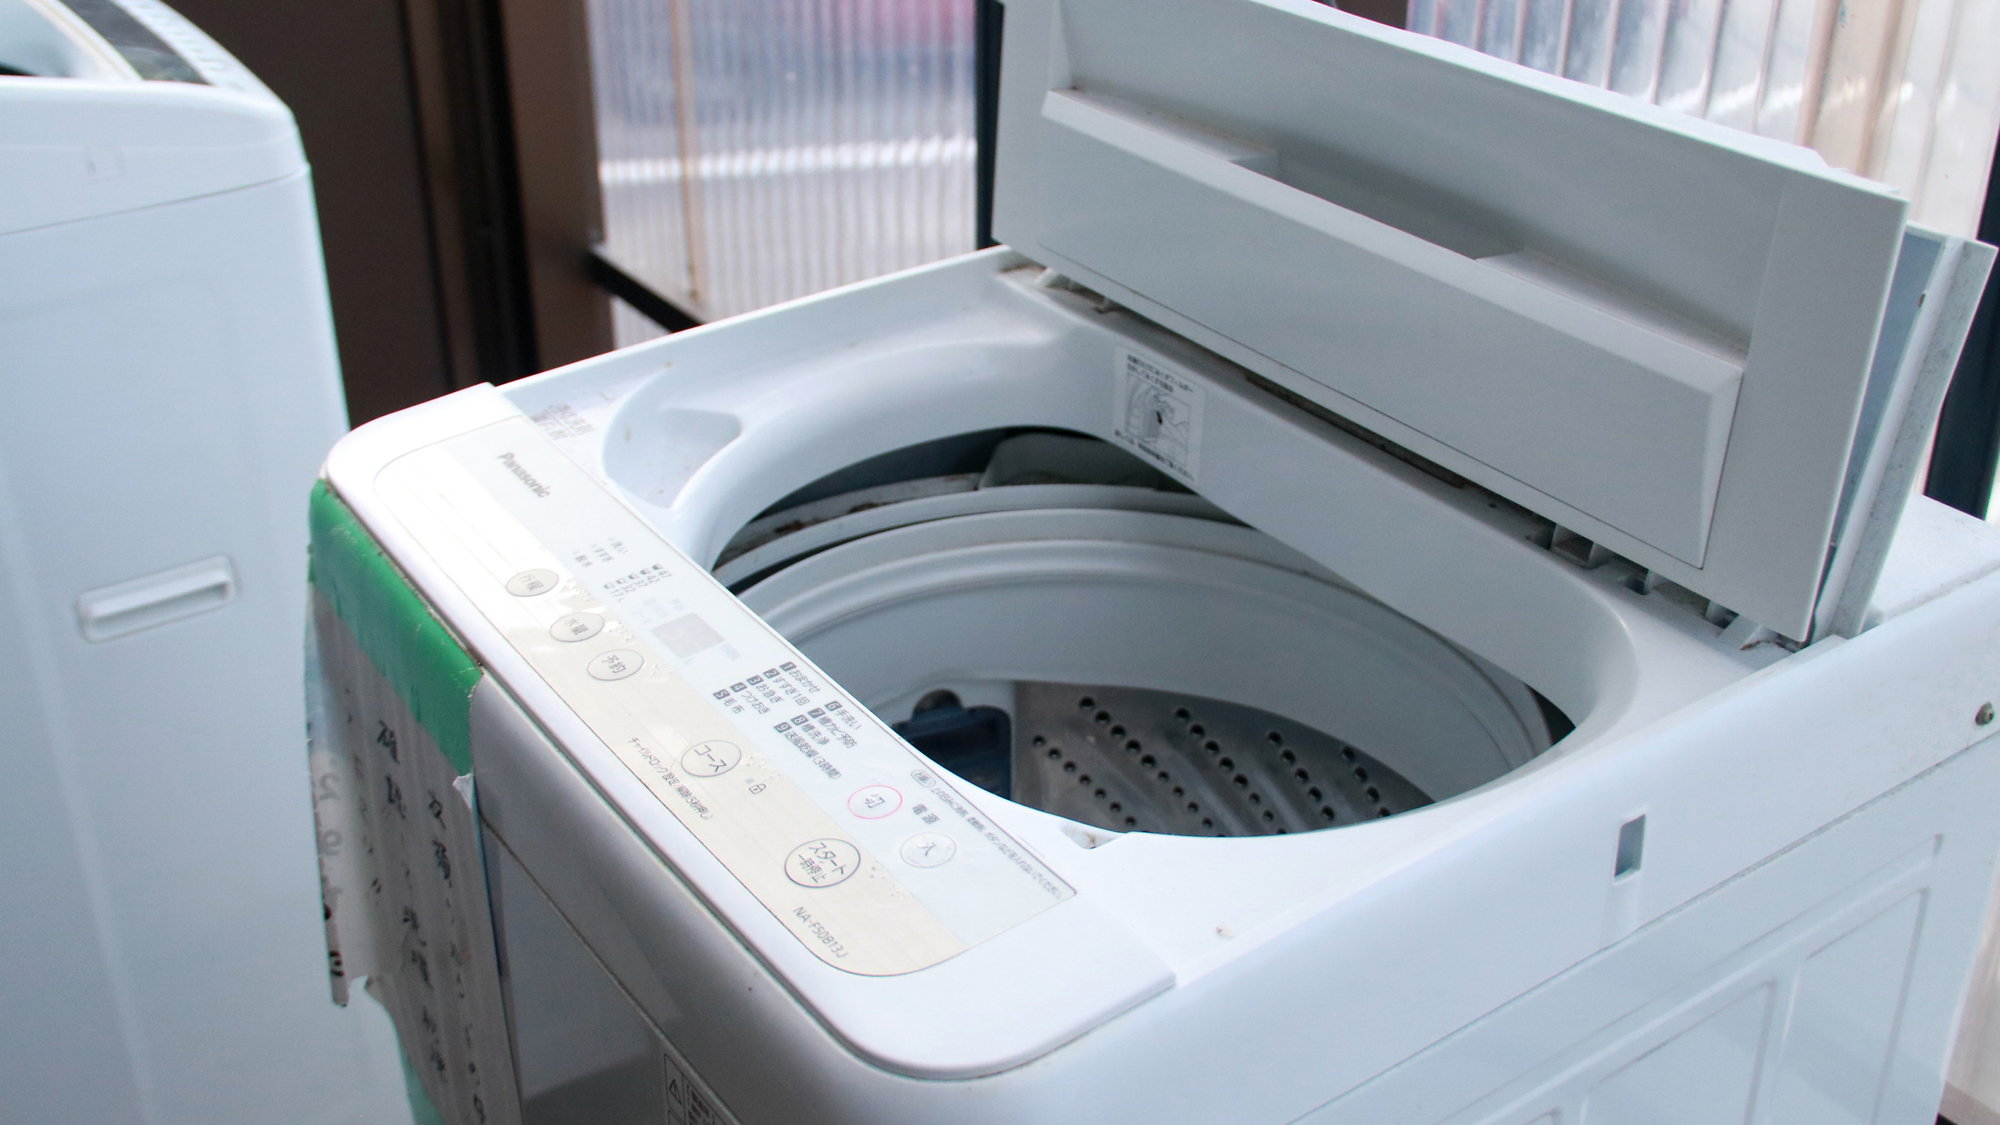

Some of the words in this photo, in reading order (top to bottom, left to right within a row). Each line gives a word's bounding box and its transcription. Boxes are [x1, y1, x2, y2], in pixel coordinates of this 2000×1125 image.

[499, 452, 550, 498] Panasonic
[519, 574, 544, 592] 行程
[633, 579, 648, 588] 37
[647, 575, 660, 584] 42
[659, 570, 672, 579] 47
[621, 584, 636, 593] 32
[564, 618, 589, 635] 水量
[602, 654, 627, 673] 予約
[781, 662, 795, 671] 1
[789, 670, 822, 694] おまかせ
[715, 690, 729, 698] 5
[748, 676, 762, 684] 3
[756, 684, 785, 703] お急ぎ
[765, 669, 779, 678] 2
[773, 676, 810, 706] すすぎ1回
[732, 683, 746, 692] 4
[741, 691, 771, 714] つけおき
[793, 716, 807, 724] 8
[810, 709, 824, 717] 7
[826, 702, 840, 710] 6
[835, 709, 862, 730] 手洗い
[776, 723, 790, 732] 9
[694, 745, 727, 772] コース
[865, 794, 885, 808] 切
[912, 803, 940, 825] 電源
[917, 842, 936, 856] 入
[808, 842, 847, 875] スタート
[798, 854, 827, 884] 一時停止
[793, 906, 849, 958] NA-F50B13J
